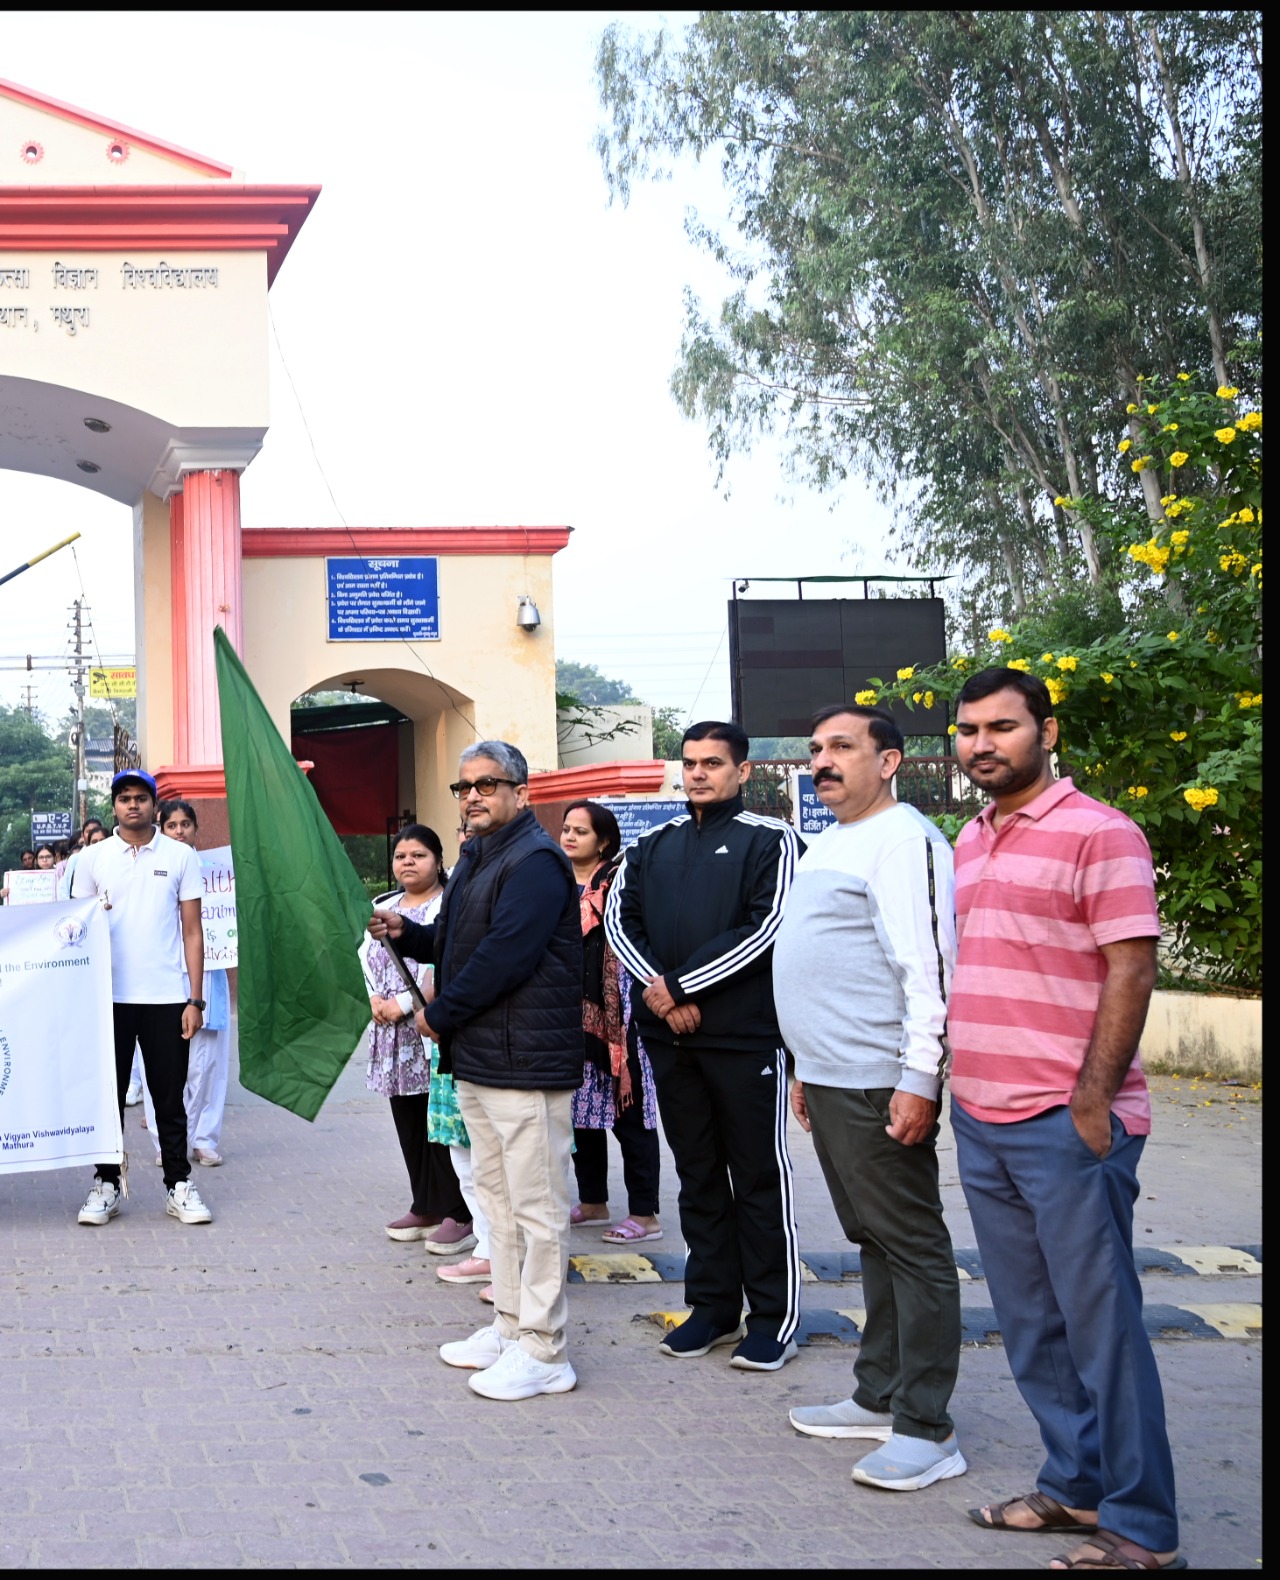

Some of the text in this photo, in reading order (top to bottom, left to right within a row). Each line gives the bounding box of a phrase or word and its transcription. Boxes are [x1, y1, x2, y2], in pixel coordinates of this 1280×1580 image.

[52, 261, 99, 291] विज्ञान
[120, 261, 219, 289] विश्वविद्यालय
[50, 305, 90, 336] मथुरा
[368, 560, 399, 571] सूचना
[802, 793, 815, 805] यह
[803, 820, 821, 831] वर्जित
[5, 962, 21, 973] the
[24, 955, 90, 971] Environment
[4, 1132, 31, 1143] Vigyan
[32, 1125, 95, 1139] Vishwavidyalaya
[2, 1141, 35, 1151] Mathura
